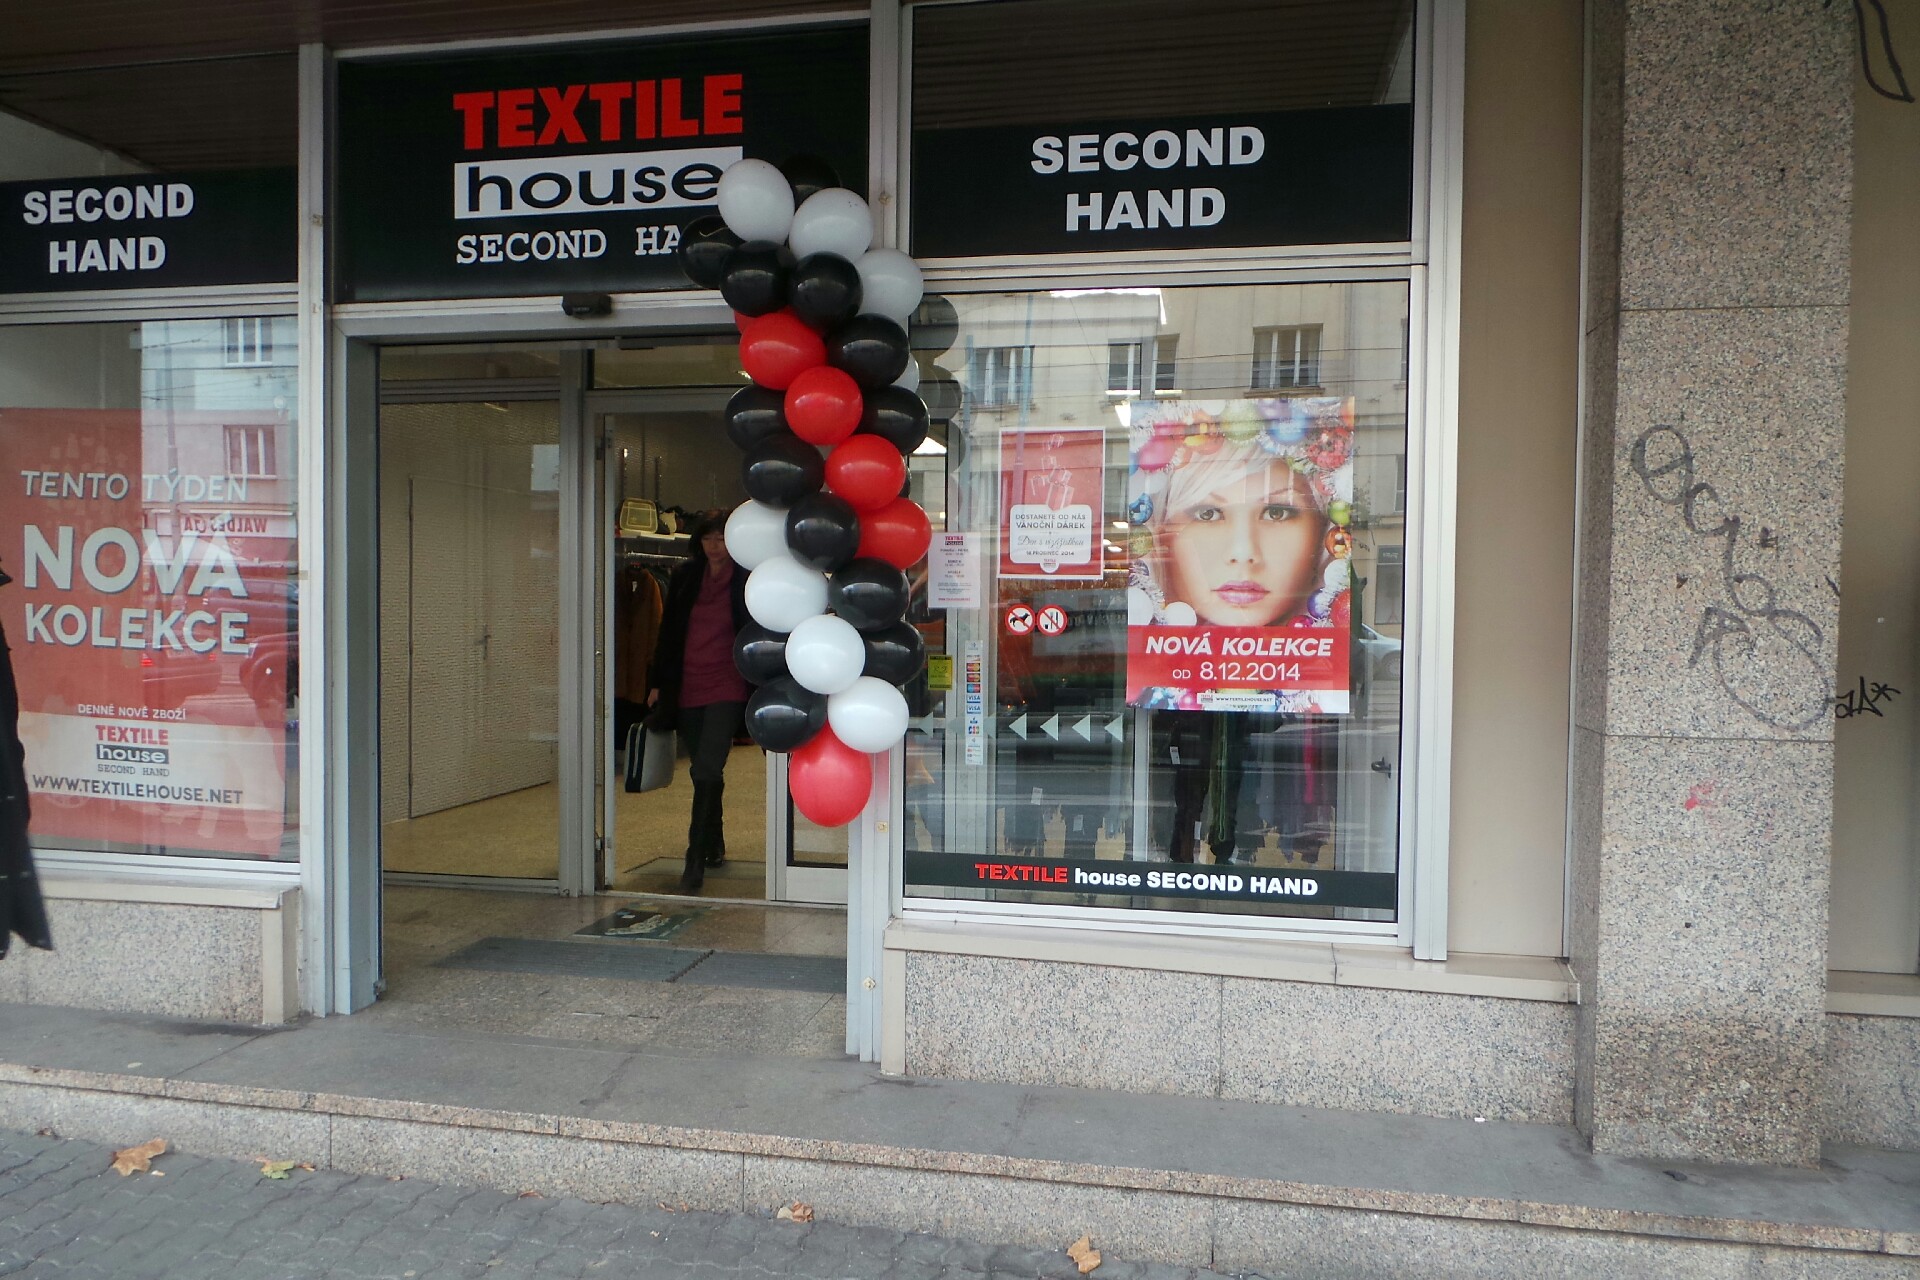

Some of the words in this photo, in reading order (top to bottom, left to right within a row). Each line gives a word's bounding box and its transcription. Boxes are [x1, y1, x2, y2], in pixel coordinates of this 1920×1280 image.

[453, 74, 743, 150] TEXTILE
[1031, 126, 1265, 174] SECOND
[23, 183, 194, 225] SECOND
[468, 162, 724, 212] house
[1066, 187, 1226, 232] HAND
[49, 236, 166, 274] HAND
[456, 229, 607, 264] SECOND
[635, 225, 682, 256] HA
[21, 470, 129, 500] TENTO
[142, 467, 248, 502] TÝDEN
[1015, 520, 1054, 529] VÁNOČNÍ
[1056, 520, 1085, 529] DÁREK
[24, 511, 249, 598] NOVÁ
[25, 603, 250, 655] KOLEKCE
[1145, 632, 1212, 656] NOVÁ
[1222, 637, 1334, 657] KOLEKCE
[1172, 669, 1191, 679] OD
[1200, 661, 1301, 681] 8.12.2014
[152, 707, 186, 720] ZBOŽÍ
[95, 725, 169, 746] TEXTILE
[97, 764, 136, 775] SECOND
[142, 766, 170, 777] HAND
[99, 745, 166, 763] house
[32, 774, 243, 804] WWW.TEXTILEHOUSE.NET
[974, 863, 1068, 883] TEXTILE
[1075, 867, 1141, 886] house
[1147, 871, 1243, 893] SECOND
[1250, 876, 1319, 896] HAND
